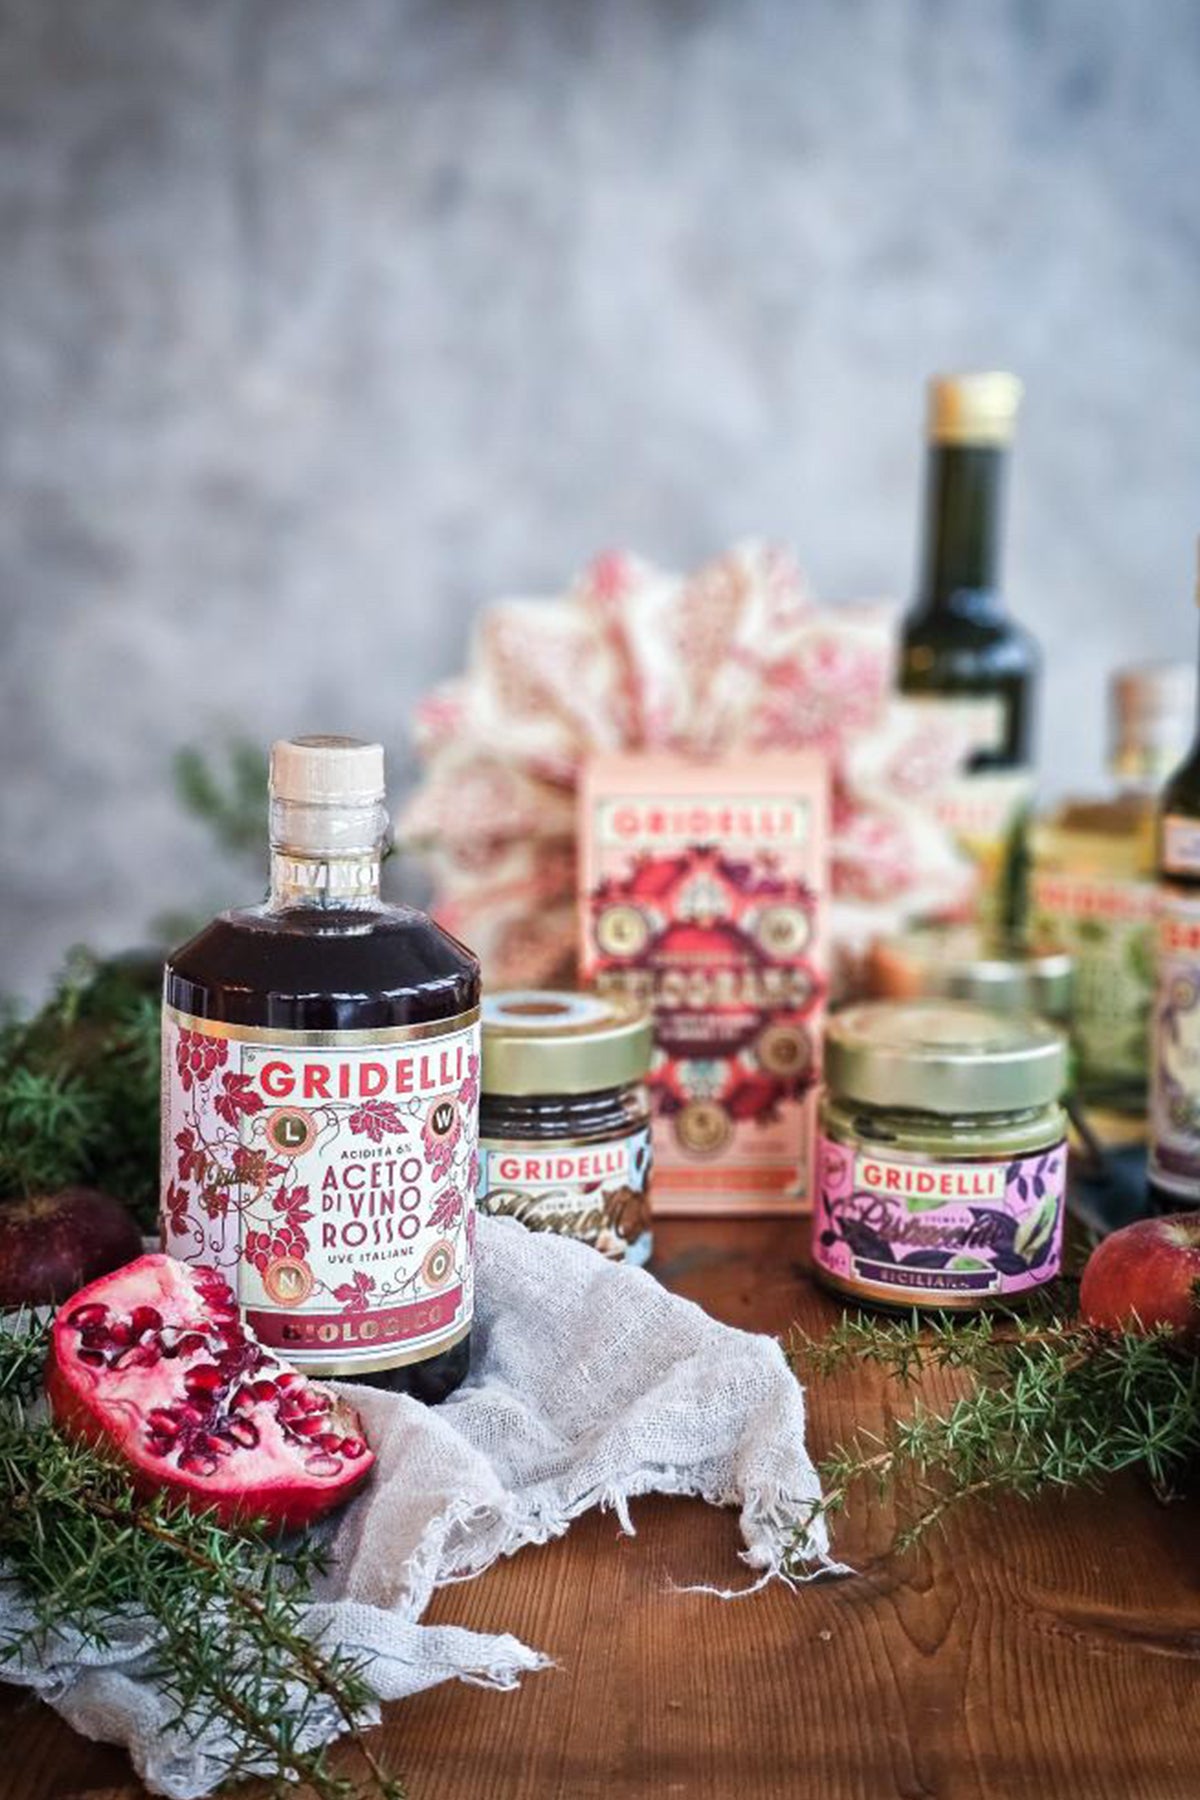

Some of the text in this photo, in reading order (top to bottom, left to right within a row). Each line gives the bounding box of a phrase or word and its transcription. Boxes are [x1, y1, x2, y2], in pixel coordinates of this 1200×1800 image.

[613, 807, 795, 837] GRIDELLI
[259, 1046, 463, 1099] GRIDELLI
[285, 1121, 300, 1141] L
[436, 1106, 453, 1129] W
[321, 1157, 422, 1190] ACETO
[500, 1150, 624, 1181] GRIDELLI
[863, 1163, 995, 1195] GRIDELLI
[322, 1185, 421, 1218] DI VINO
[322, 1213, 421, 1248] ROSSO
[327, 1246, 414, 1264] UVE ITALIANE
[431, 1257, 445, 1276] O
[279, 1270, 296, 1290] N
[282, 1304, 442, 1343] BIOLOGCO
